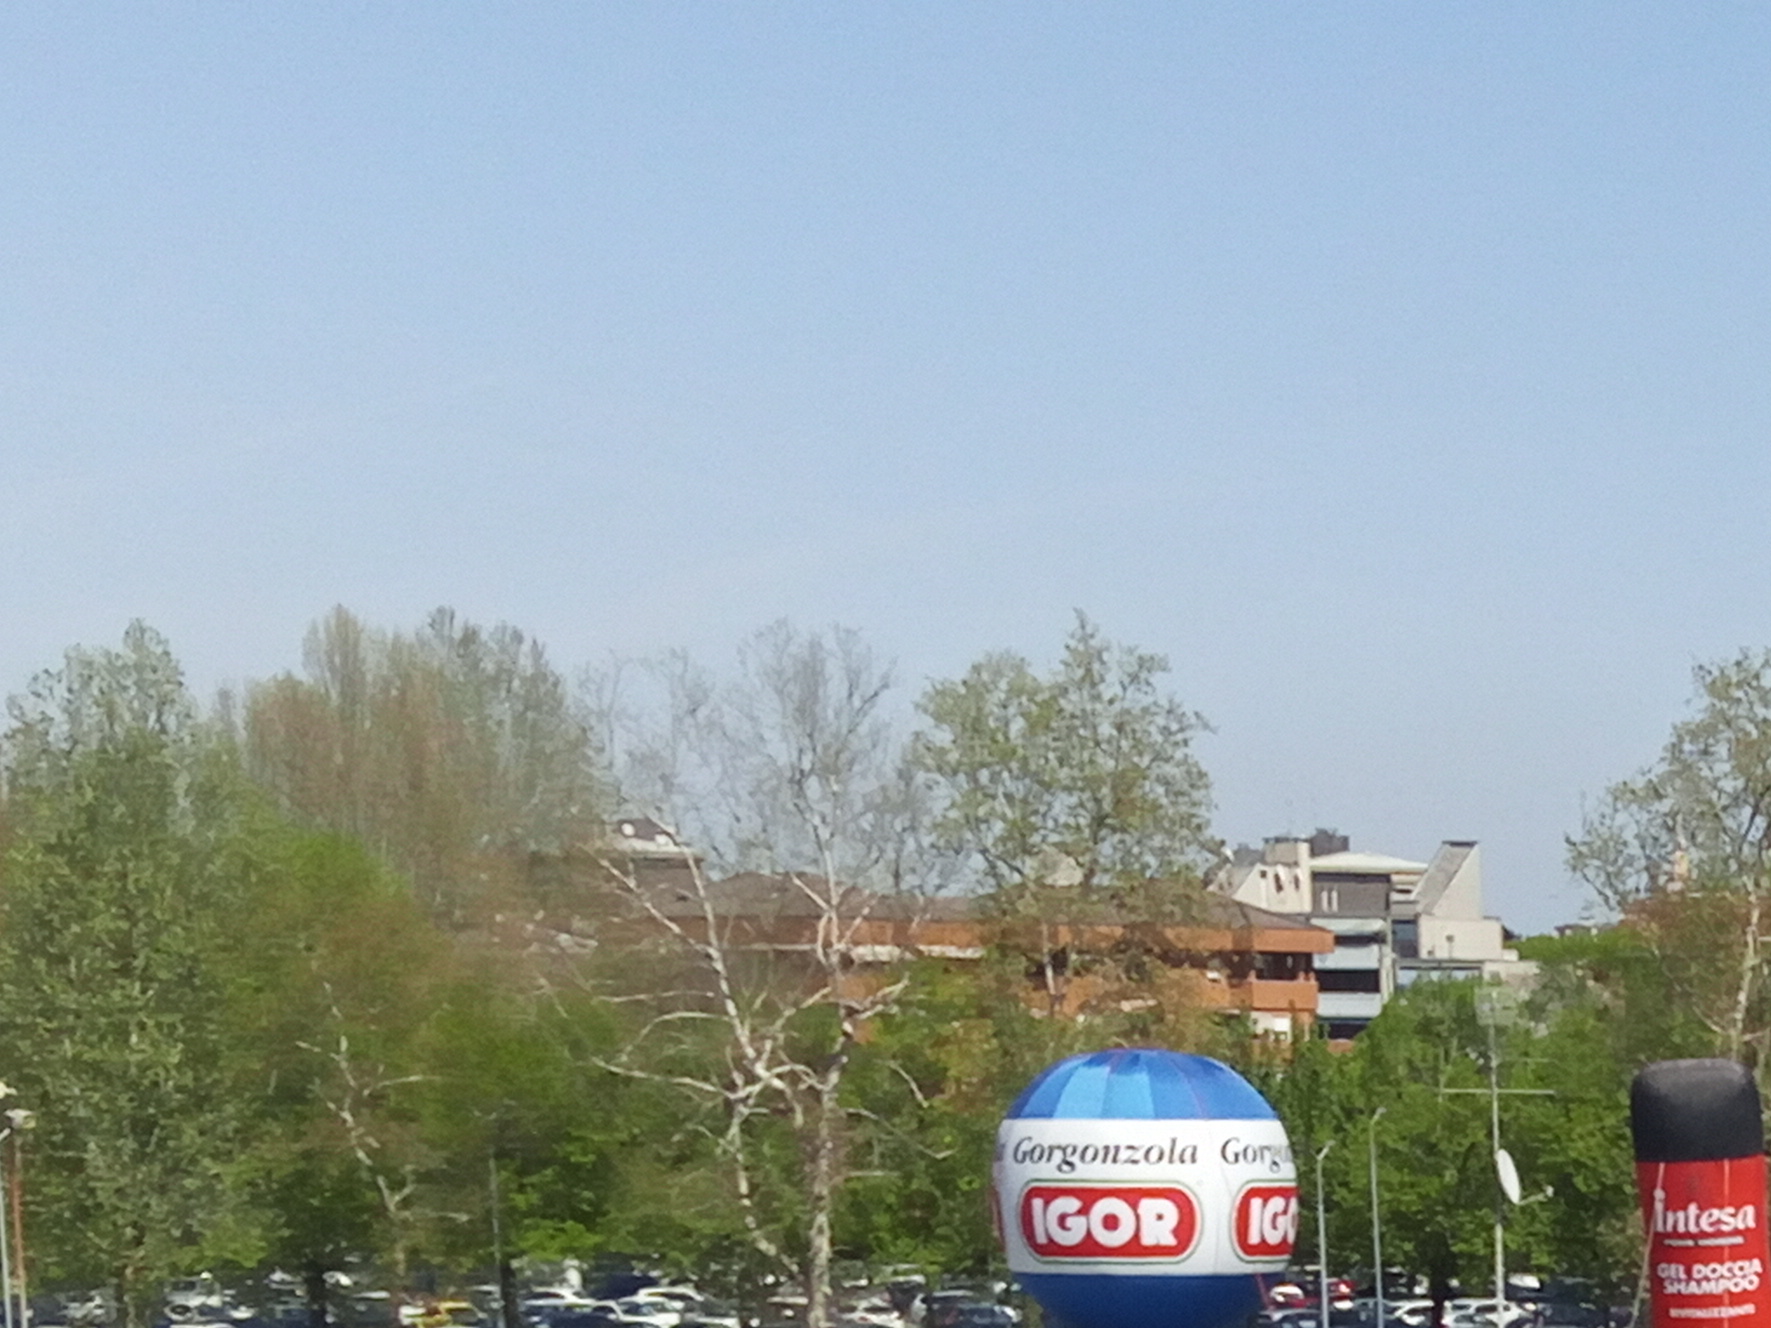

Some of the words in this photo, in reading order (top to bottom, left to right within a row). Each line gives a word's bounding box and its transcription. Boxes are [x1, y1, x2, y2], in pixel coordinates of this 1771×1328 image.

[1013, 1136, 1198, 1173] Gorgonzola
[1030, 1196, 1179, 1247] IGOR
[1656, 1262, 1687, 1280] GEL
[1691, 1257, 1763, 1280] DOCCIA
[1662, 1274, 1760, 1295] SHAMPOO
